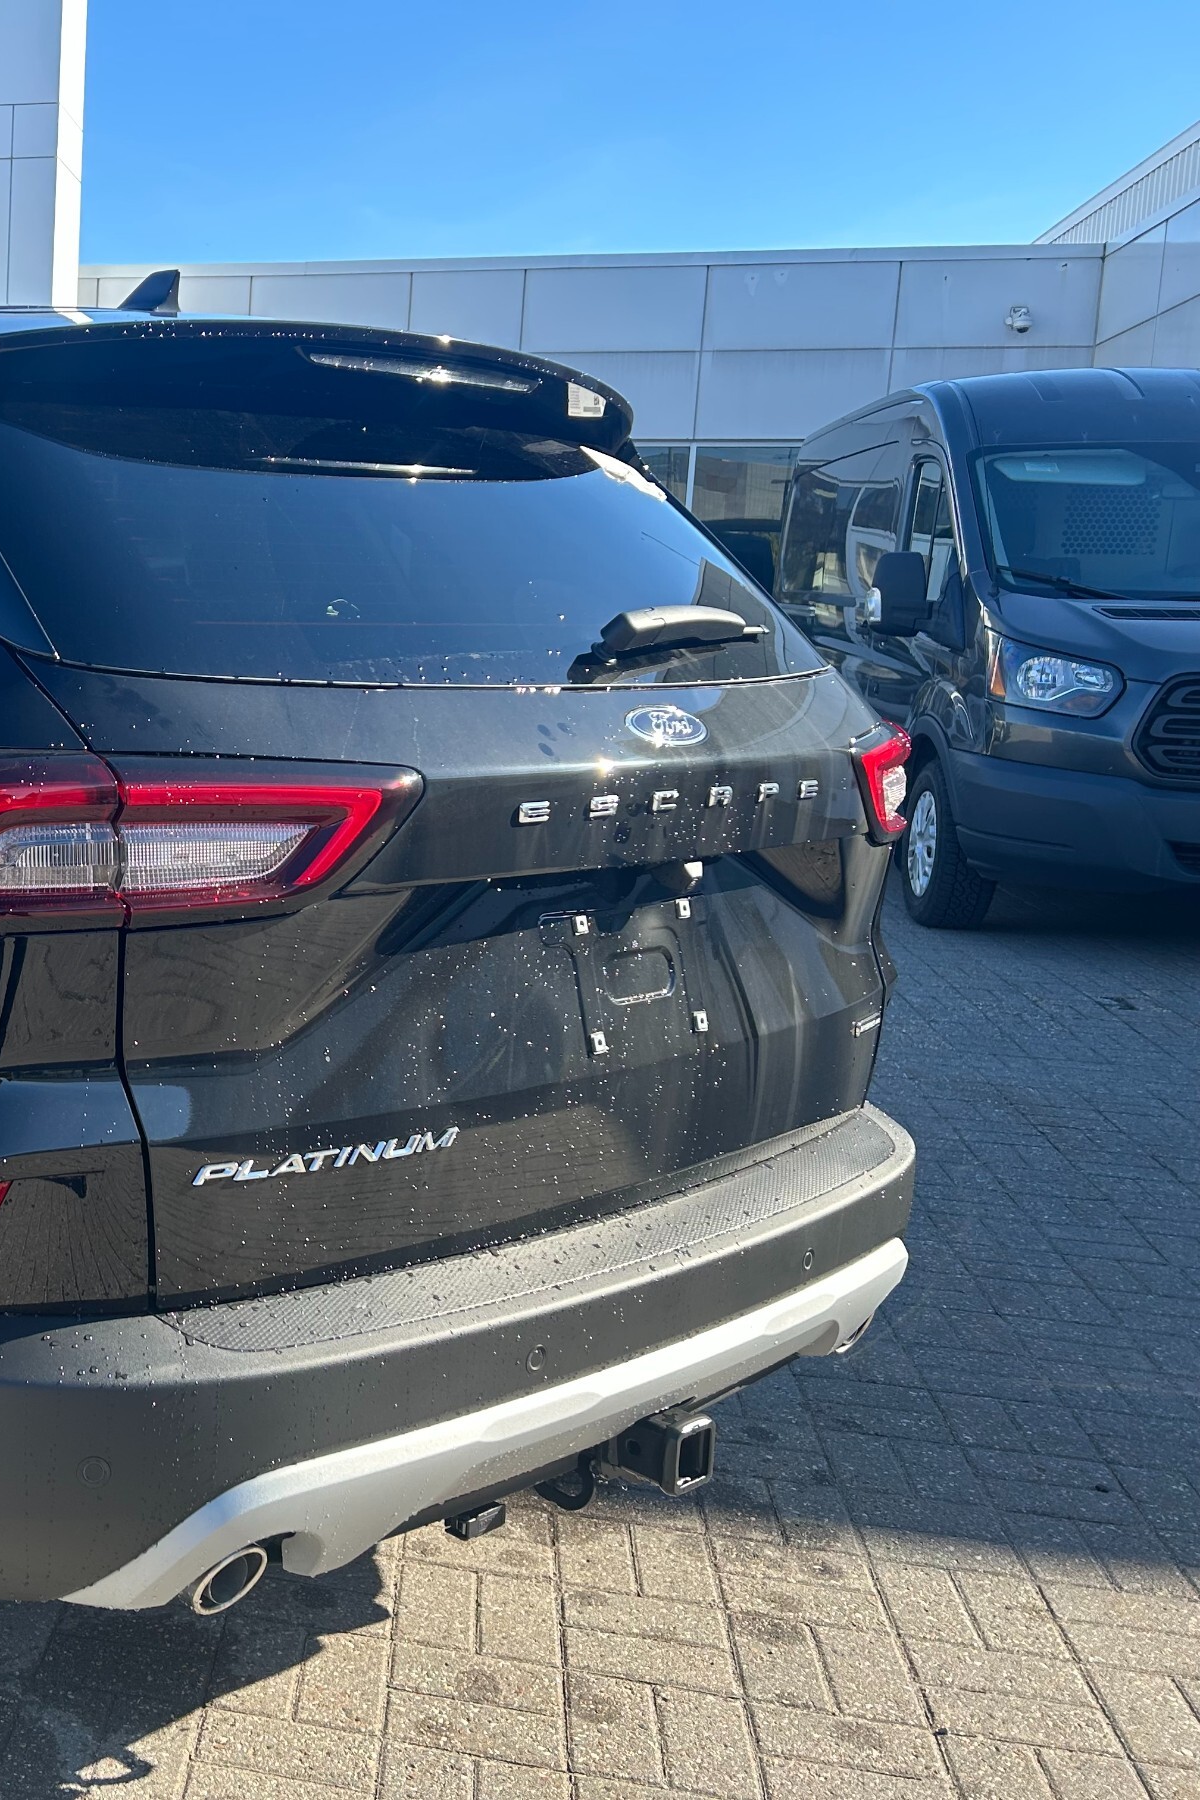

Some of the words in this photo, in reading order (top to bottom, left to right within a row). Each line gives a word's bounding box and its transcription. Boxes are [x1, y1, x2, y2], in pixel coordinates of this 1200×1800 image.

[648, 711, 693, 735] Ford
[517, 779, 819, 824] ESCAPE
[192, 1125, 460, 1186] PLATINUM
